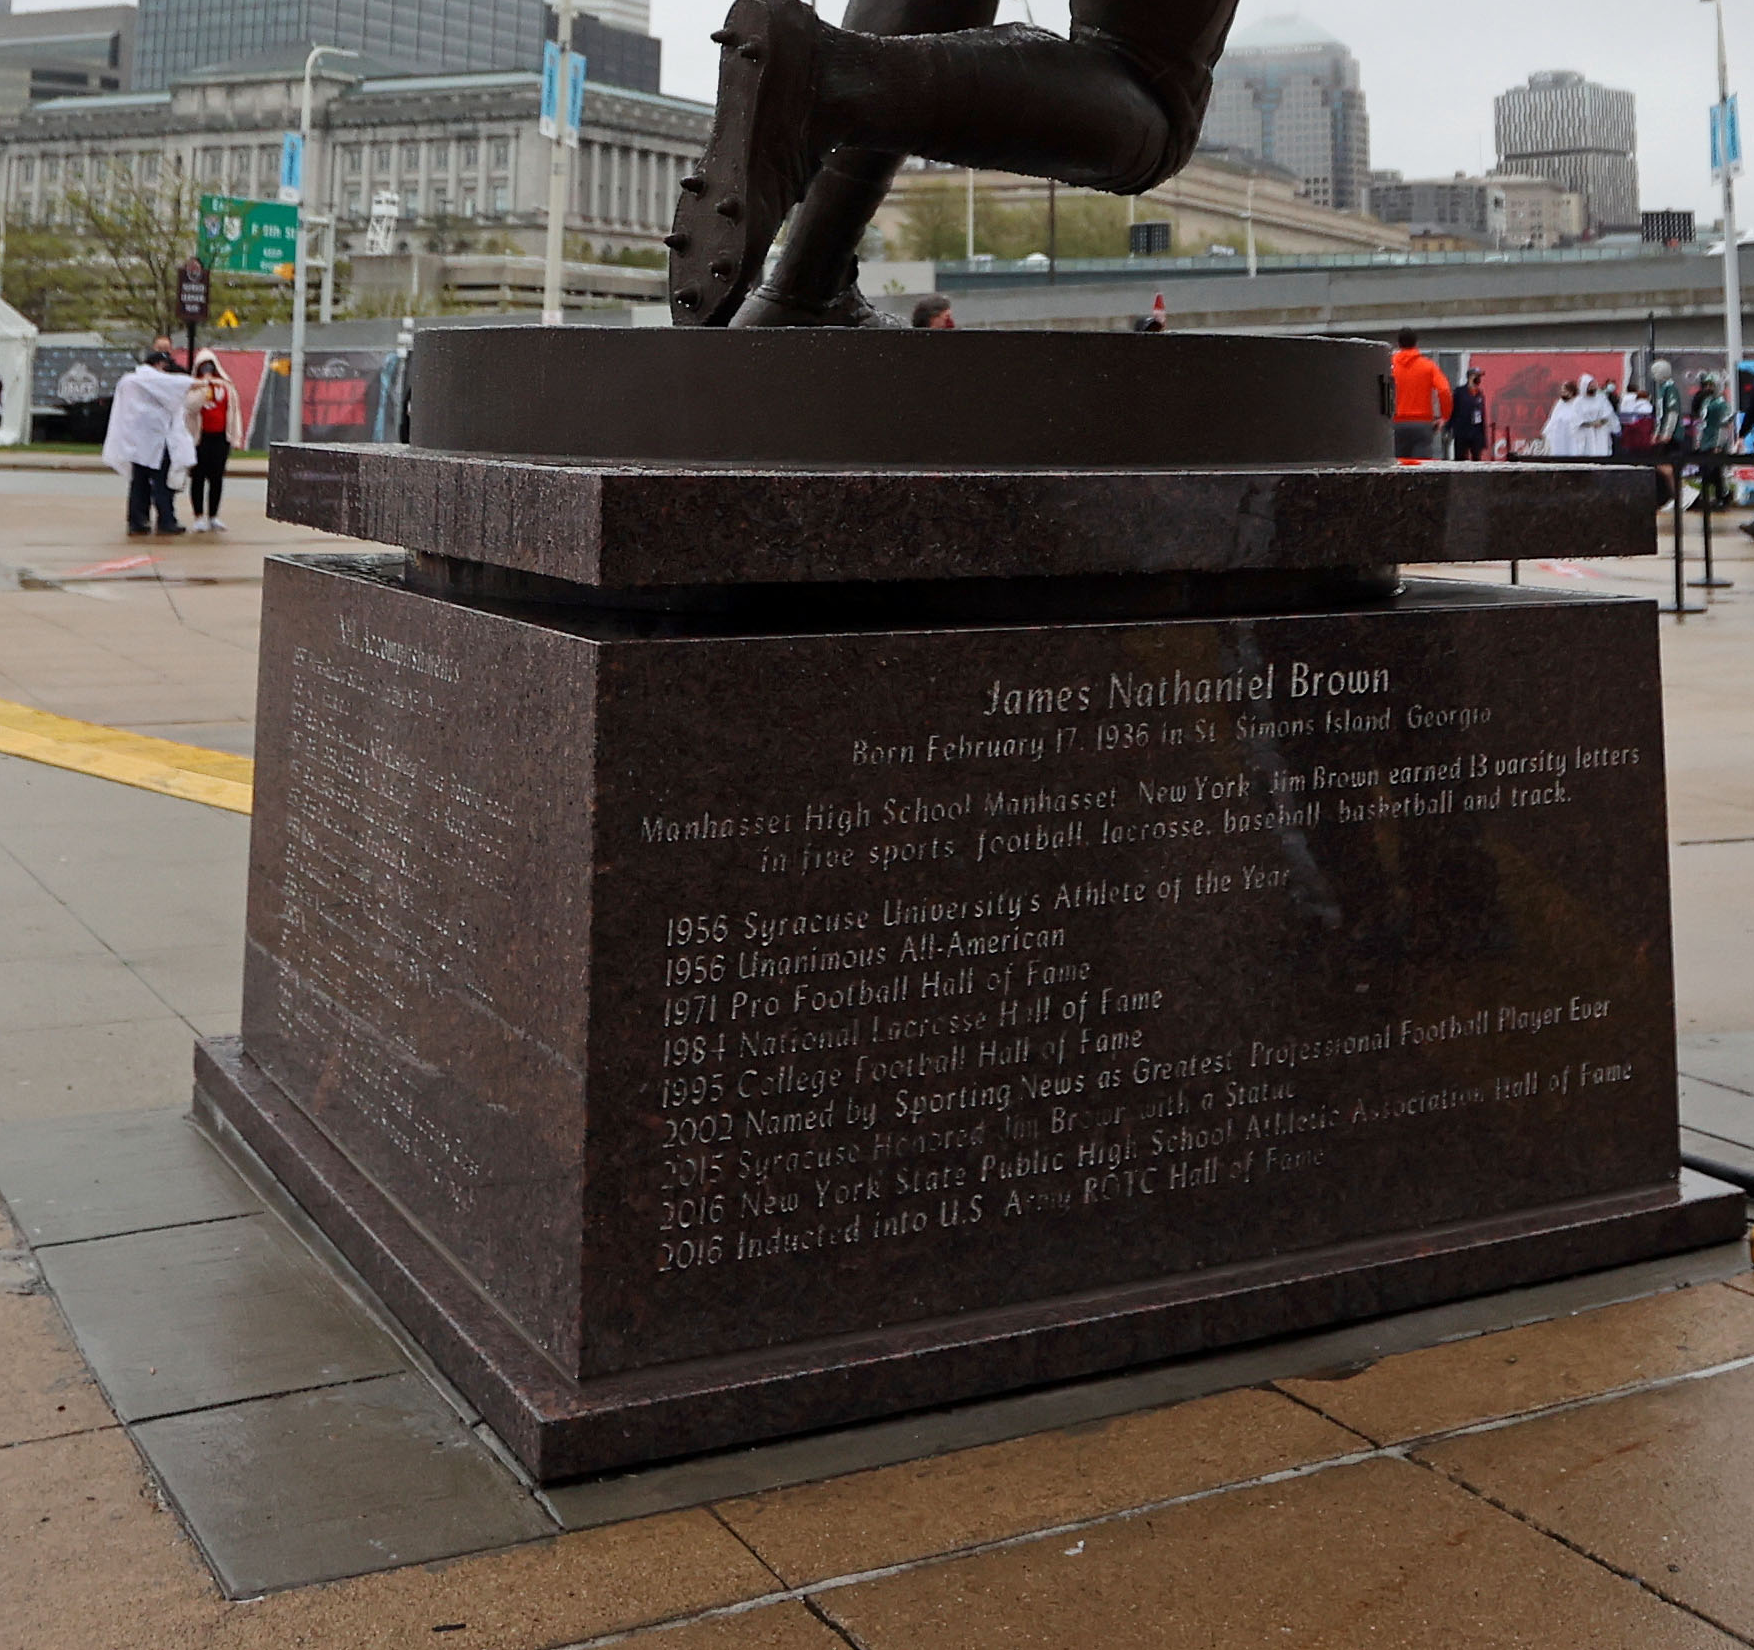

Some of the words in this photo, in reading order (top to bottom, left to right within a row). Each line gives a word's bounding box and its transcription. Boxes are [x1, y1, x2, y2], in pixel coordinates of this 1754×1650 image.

[983, 680, 1091, 715] James
[1109, 663, 1274, 709] Nathaniel
[1291, 662, 1389, 698] Brown
[852, 739, 914, 765] Born
[927, 735, 1044, 761] February
[1098, 723, 1149, 751] 1936
[1162, 723, 1183, 746] in
[1236, 712, 1315, 741] Simons
[1407, 704, 1491, 732] Georgia
[642, 812, 791, 842] Manhasset
[805, 802, 870, 836] High
[883, 793, 971, 825] School
[1139, 780, 1186, 805] New
[1268, 773, 1305, 794] Jim
[1313, 766, 1380, 790] Brown
[1389, 756, 1460, 784] earned
[1469, 754, 1488, 778] 13
[1496, 750, 1567, 777] varsity
[1575, 746, 1640, 769] letters
[762, 847, 787, 872] in
[801, 843, 853, 876] five
[870, 838, 954, 871] sports
[1464, 786, 1500, 812] and
[1511, 780, 1572, 807] track.
[667, 915, 728, 946] 1956
[744, 911, 869, 946] Syracuse
[884, 891, 1040, 926] University's
[1054, 883, 1145, 910] Athlete
[1157, 877, 1182, 903] of
[1195, 871, 1231, 895] the
[1242, 864, 1289, 891] Year
[664, 995, 716, 1027] 1971
[732, 991, 779, 1020] Pro
[795, 975, 908, 1012] Football
[921, 967, 973, 998] Hall
[987, 962, 1013, 995] of
[1027, 960, 1090, 986] Fame
[666, 955, 726, 986] 1956
[739, 947, 886, 979] Unanimous
[900, 926, 1065, 963] All-American
[662, 1073, 723, 1108] 1995
[738, 1065, 841, 1098] College
[855, 1046, 965, 1083] Football
[979, 1036, 1030, 1067] Hall
[1045, 1030, 1065, 1065] of
[1081, 1028, 1142, 1054] Fame
[663, 1033, 726, 1067] 1984
[740, 1018, 859, 1058] National
[873, 1012, 987, 1042] Lacrosse
[1062, 991, 1088, 1024] of
[1101, 988, 1163, 1015] Fame
[662, 1113, 733, 1148] 2002
[746, 1100, 833, 1136] Named
[847, 1097, 876, 1130] by
[896, 1082, 1011, 1123] Sporting
[1021, 1074, 1085, 1100] News
[1098, 1068, 1121, 1089] as
[1133, 1051, 1232, 1084] Greatest
[1250, 1024, 1390, 1068] Professional
[1401, 1010, 1488, 1046] Football
[1498, 1006, 1562, 1034] Player
[1570, 997, 1610, 1022] Ever
[660, 1194, 725, 1230] 2016
[741, 1191, 798, 1219] New
[816, 1174, 880, 1207] York
[896, 1166, 966, 1194] State
[980, 1151, 1063, 1182] Public
[1078, 1134, 1137, 1170] High
[1151, 1118, 1233, 1155] School
[1496, 1071, 1538, 1100] Hall
[1549, 1065, 1570, 1094] of
[1580, 1061, 1632, 1086] Fame
[661, 1151, 724, 1190] 2015
[738, 1145, 859, 1185] Syracuse
[1142, 1089, 1189, 1119] with
[1201, 1092, 1214, 1110] a
[1226, 1081, 1296, 1107] Statue
[659, 1235, 723, 1272] 2016
[737, 1214, 860, 1260] Inducted
[874, 1211, 927, 1238] into
[1084, 1167, 1158, 1204] ROTC
[1170, 1156, 1218, 1189] Hall
[1230, 1150, 1253, 1182] of
